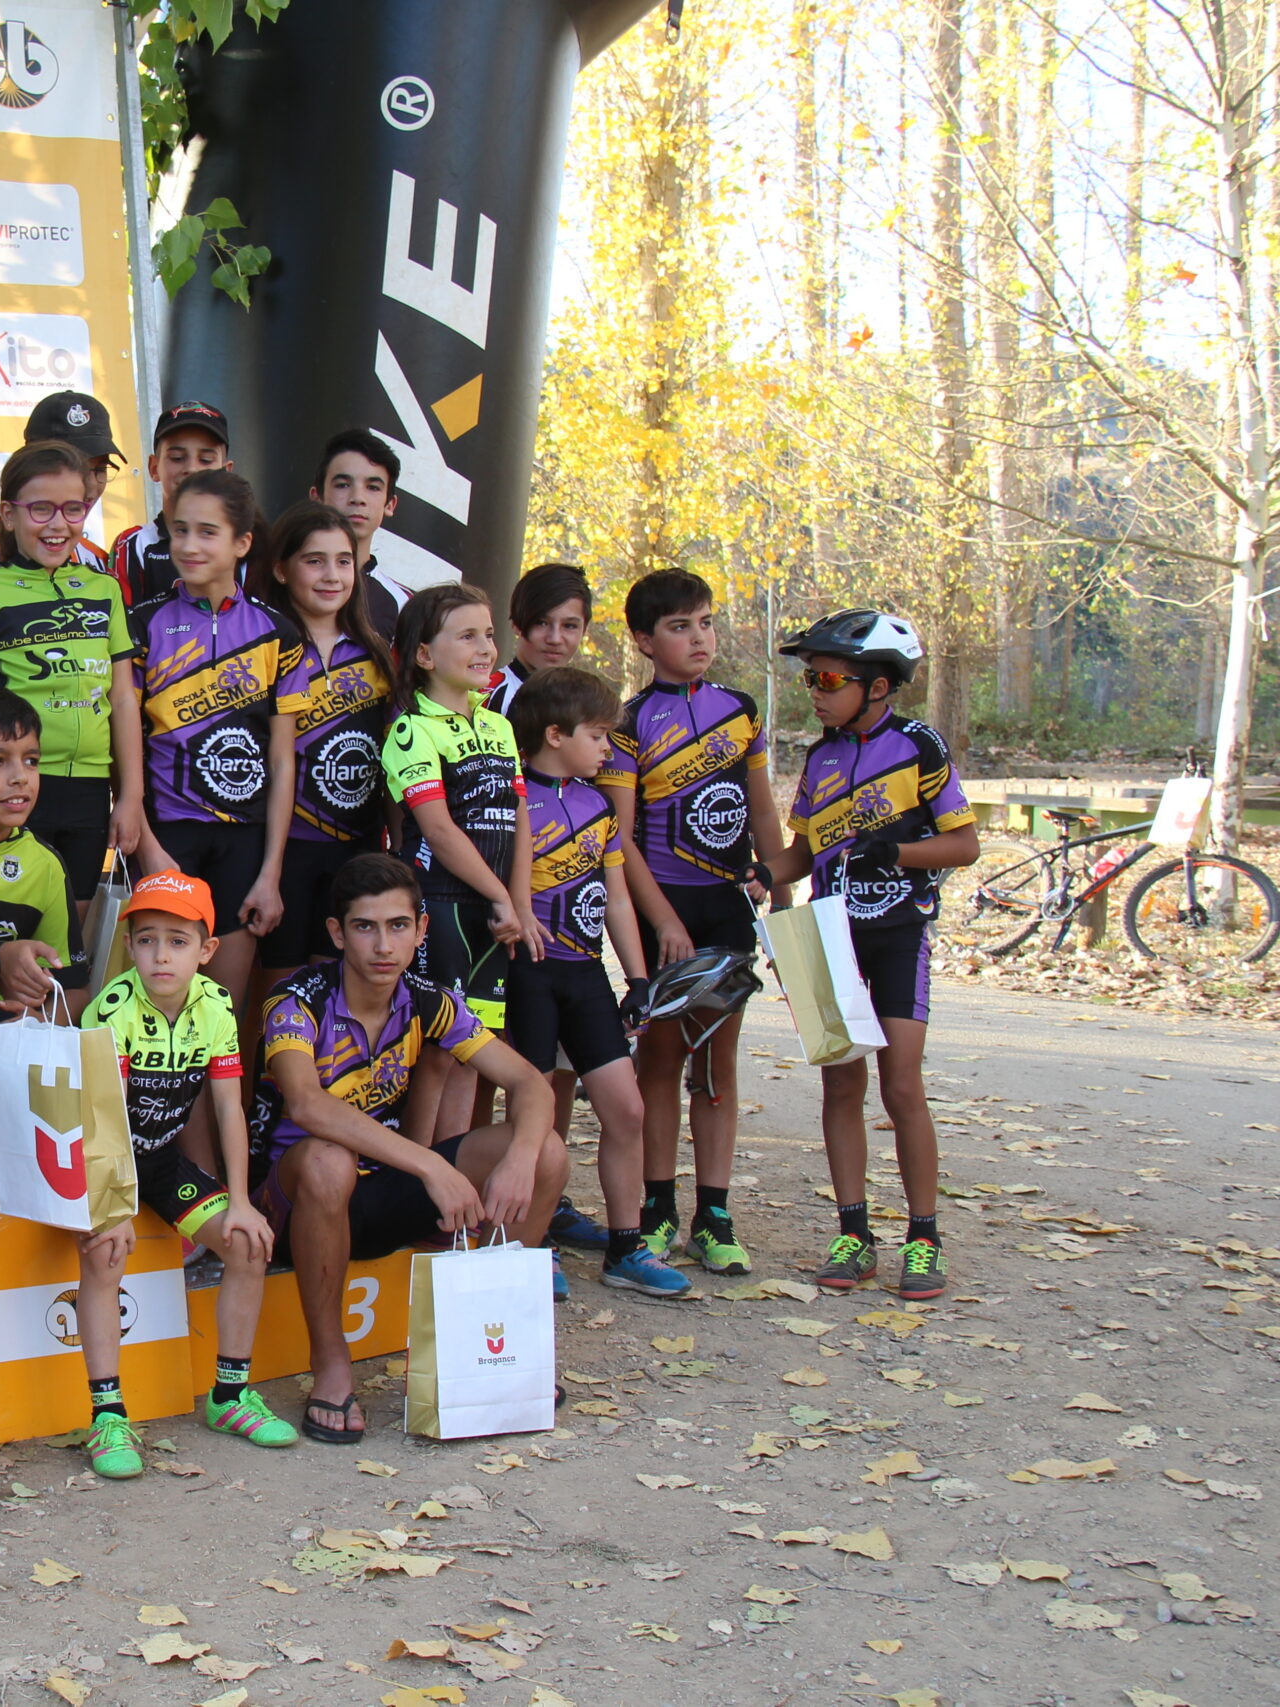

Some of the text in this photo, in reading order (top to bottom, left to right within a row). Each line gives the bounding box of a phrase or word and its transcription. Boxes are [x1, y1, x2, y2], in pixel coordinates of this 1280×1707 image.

[33, 630, 86, 643] Ciclismo
[172, 682, 219, 708] ESCOLA DE
[666, 759, 695, 780] ESCOLA
[685, 804, 748, 827] cliarcos
[815, 814, 843, 835] ESCOLA
[130, 1047, 207, 1069] BBIKE
[343, 1276, 380, 1344] 3
[477, 1355, 517, 1367] Bragança
